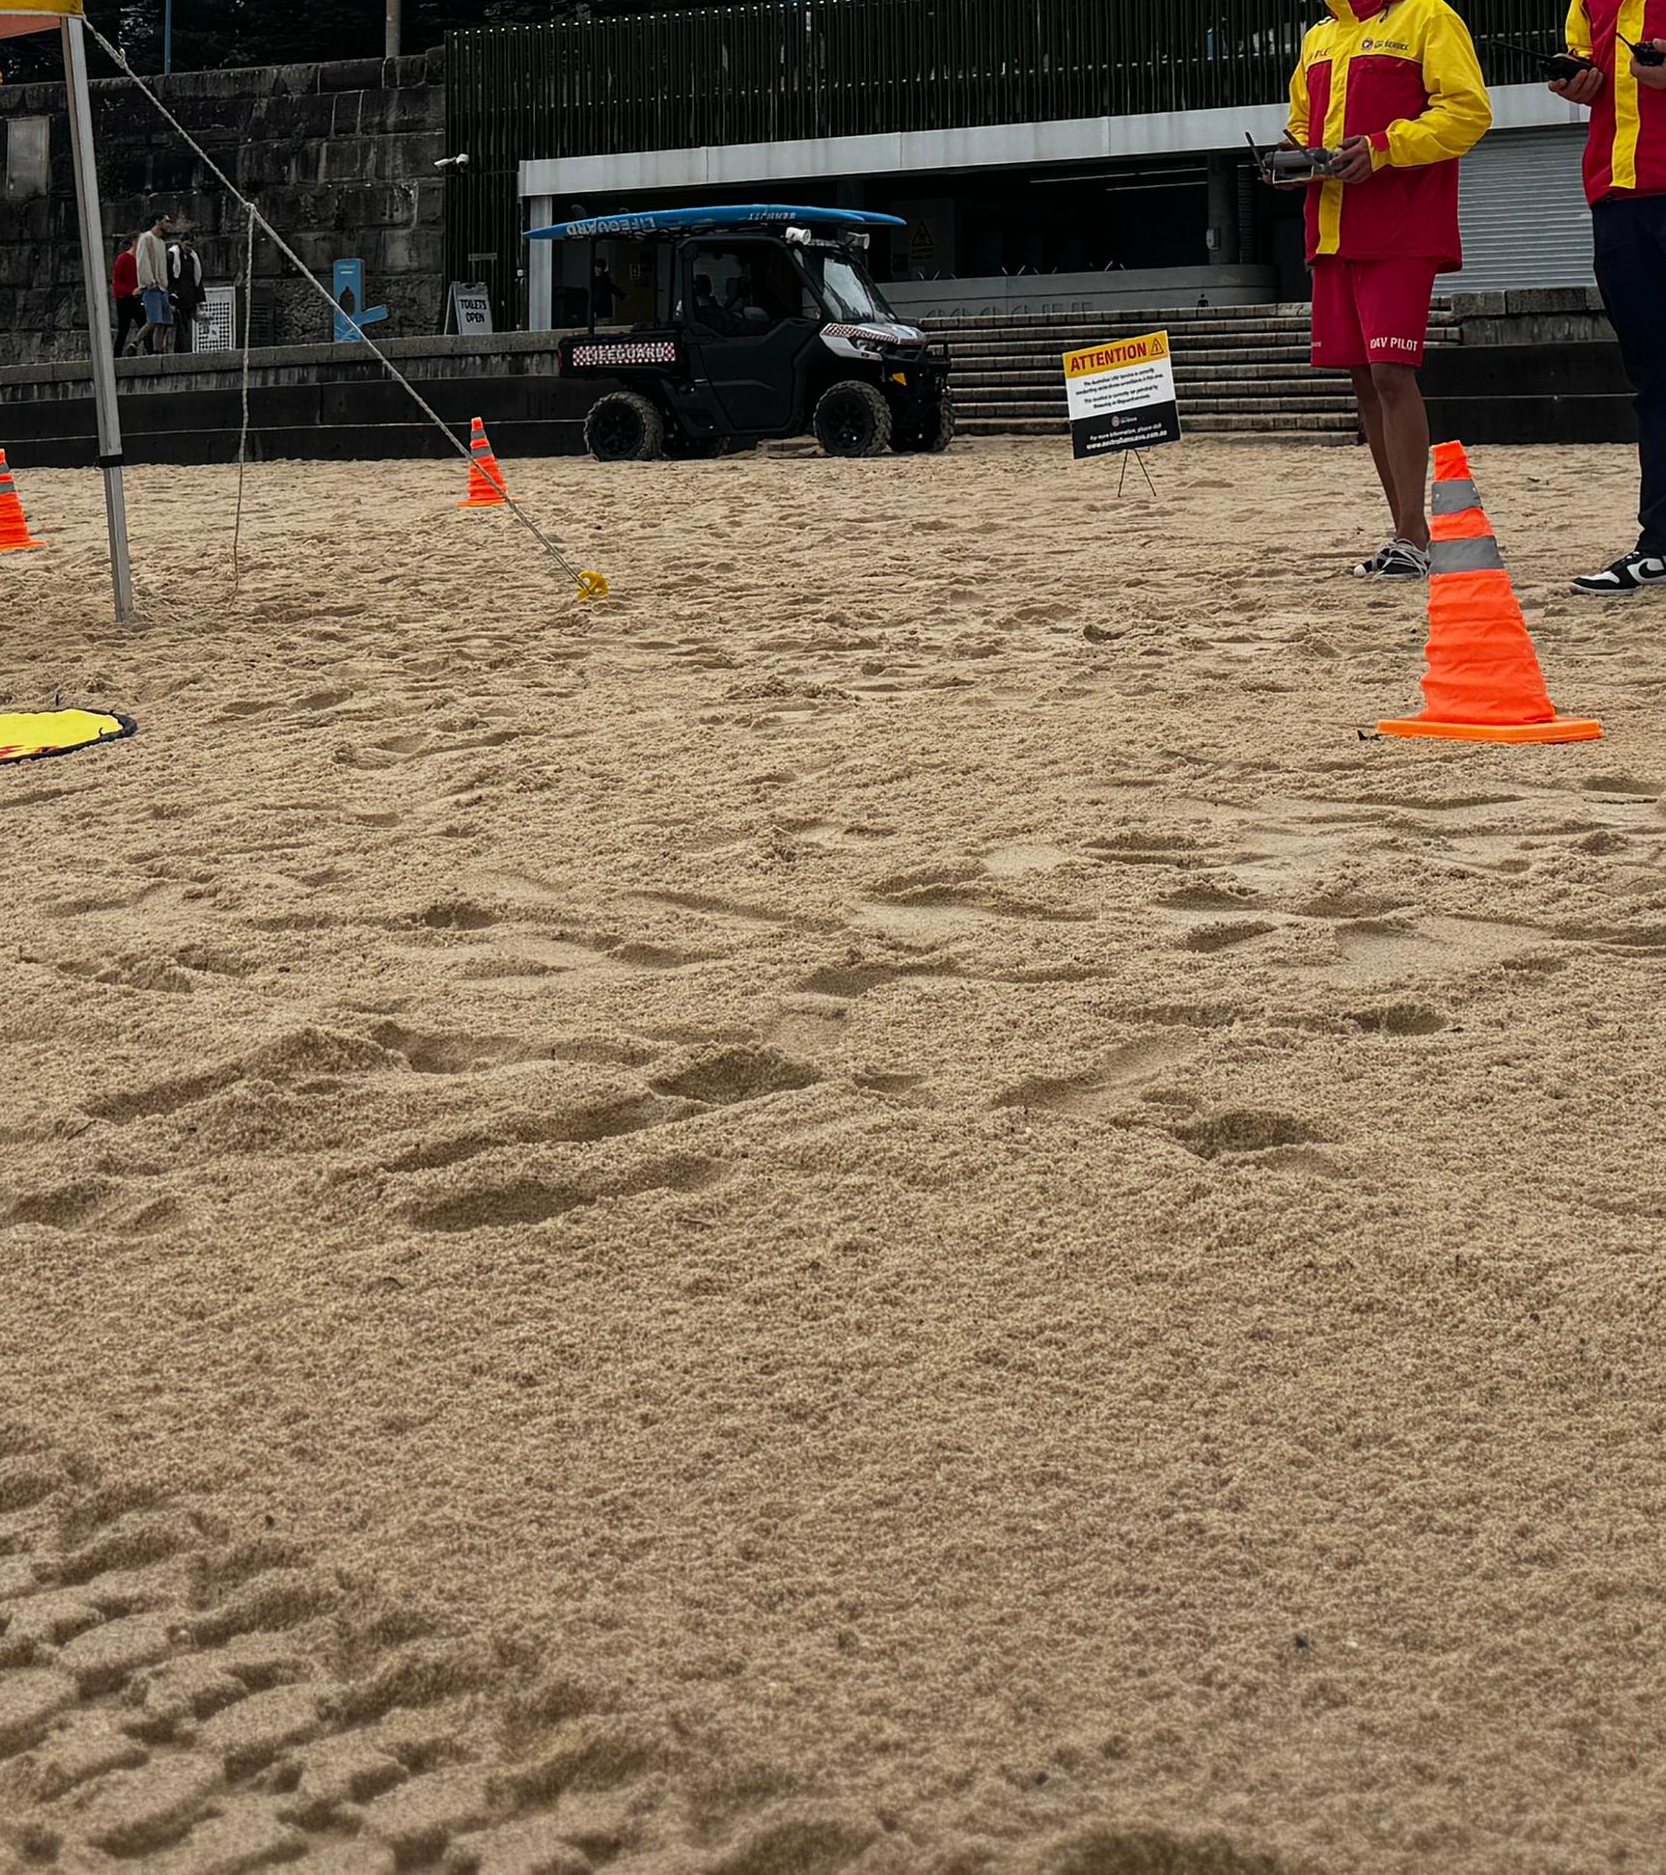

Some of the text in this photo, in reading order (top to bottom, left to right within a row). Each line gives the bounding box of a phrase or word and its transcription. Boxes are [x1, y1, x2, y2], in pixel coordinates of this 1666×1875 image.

[1390, 337, 1418, 352] PILOT
[585, 347, 665, 362] LIFEGUARD
[1071, 342, 1147, 373] ATTENTION
